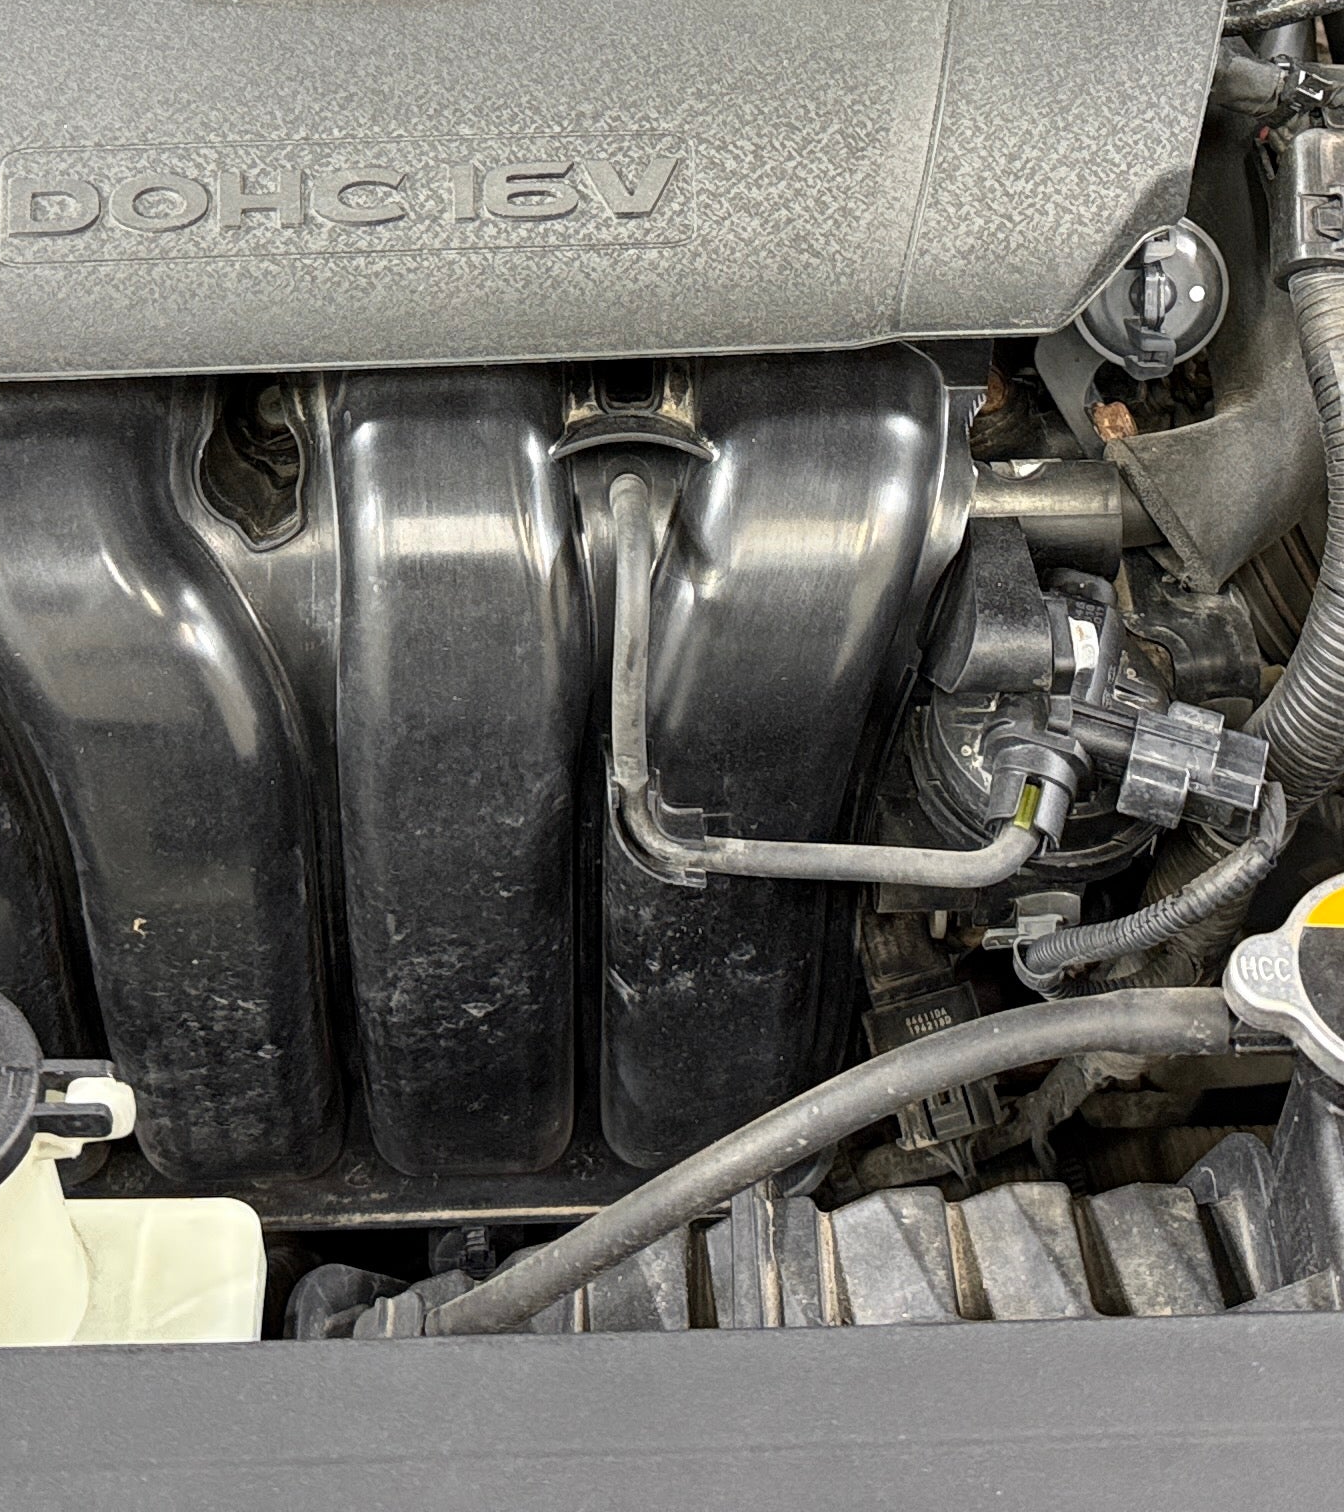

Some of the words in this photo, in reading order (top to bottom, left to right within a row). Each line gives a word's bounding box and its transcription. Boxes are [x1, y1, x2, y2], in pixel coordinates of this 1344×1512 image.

[7, 167, 407, 239] DOHC
[454, 158, 681, 222] 16V
[1239, 955, 1292, 983] HCC
